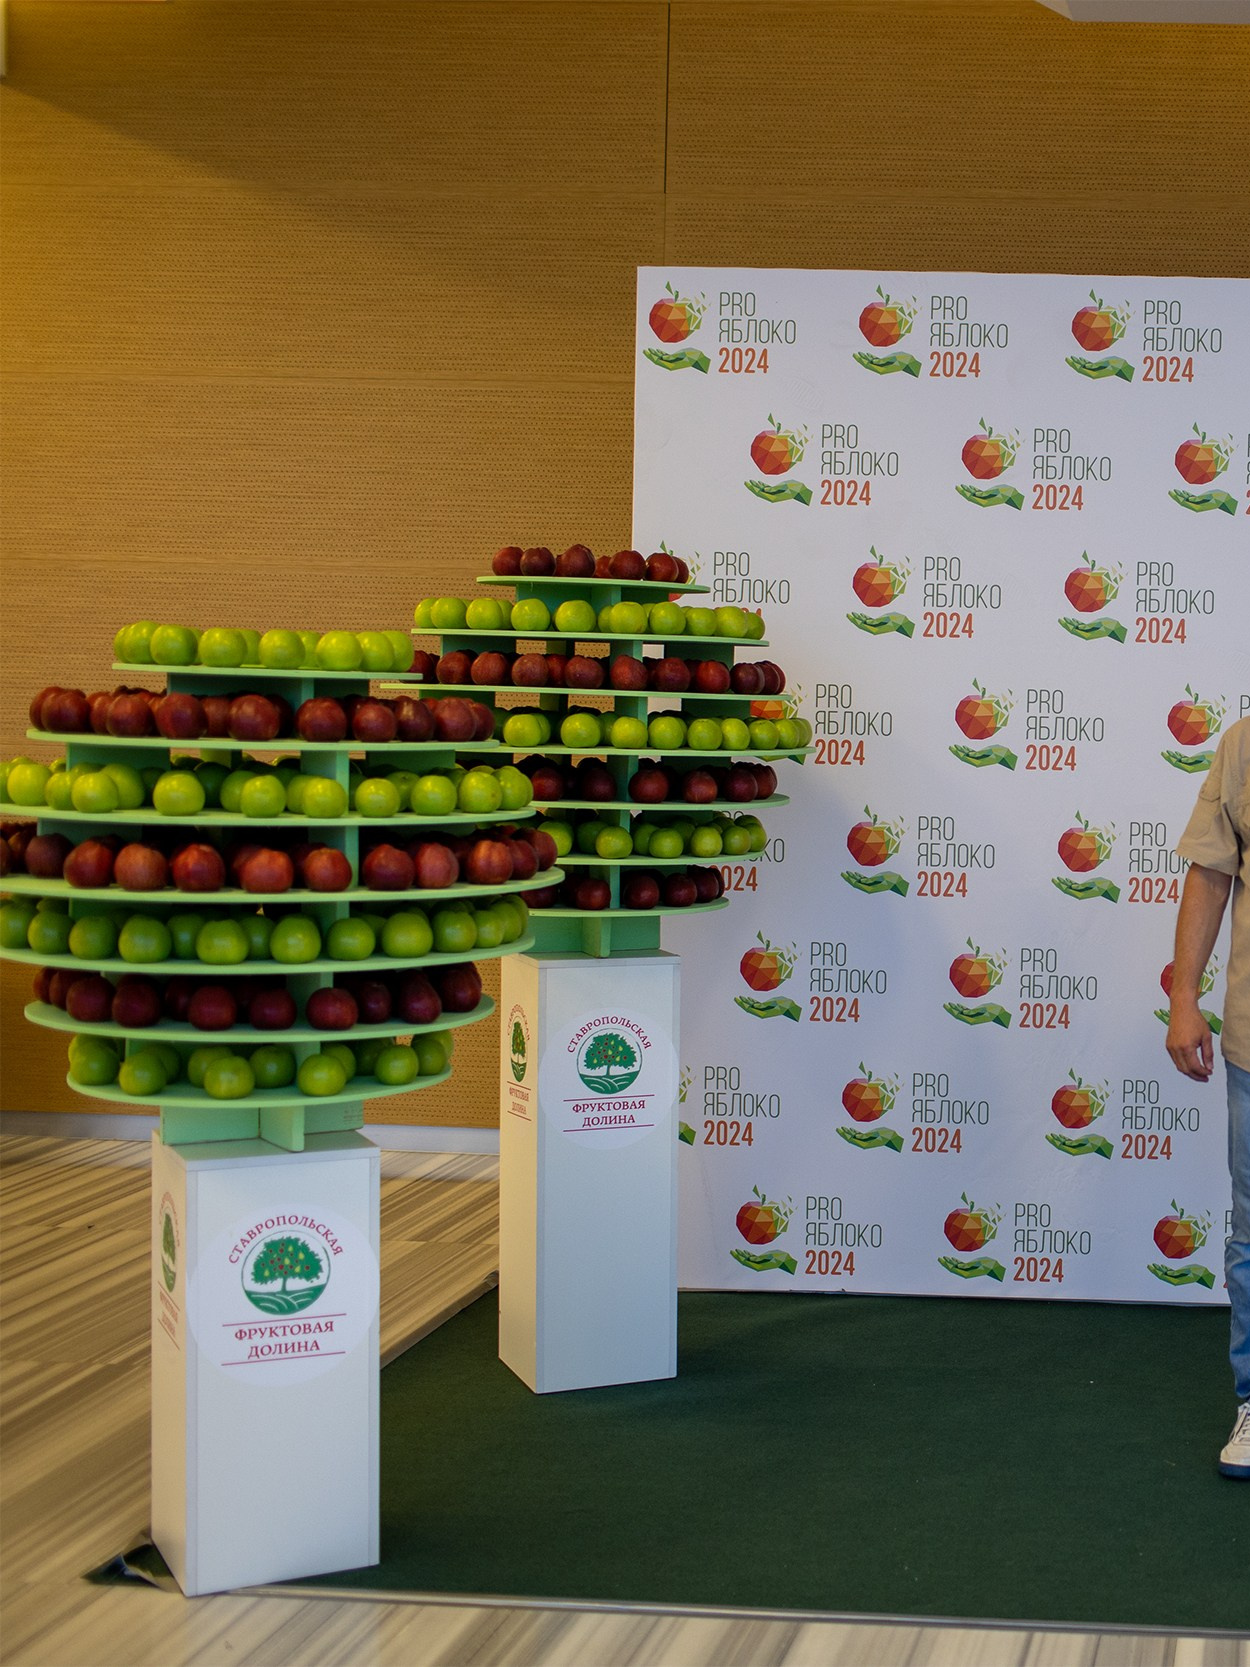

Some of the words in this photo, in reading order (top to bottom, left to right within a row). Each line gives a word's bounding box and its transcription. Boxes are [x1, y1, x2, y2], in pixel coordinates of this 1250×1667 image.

[719, 292, 755, 317] PRO
[931, 296, 967, 320] PRO
[1144, 300, 1181, 325] PRO
[719, 319, 796, 344] ЯБЛОКО
[930, 322, 1008, 348] ЯБЛОКО
[1143, 327, 1222, 353] ЯБЛОКО
[718, 347, 769, 374] 2024
[929, 351, 981, 378] 2024
[1142, 355, 1194, 383] 2024
[822, 424, 858, 449] PRO
[1034, 428, 1070, 453] PRO
[821, 451, 898, 476] ЯБЛОКО
[1033, 455, 1111, 481] ЯБЛОКО
[820, 479, 871, 506] 2024
[1032, 484, 1083, 511] 2024
[714, 552, 750, 577] PRO
[924, 556, 960, 581] PRO
[1137, 562, 1173, 586] PRO
[713, 578, 790, 604] ЯБЛОКО
[923, 582, 1001, 609] ЯБЛОКО
[1136, 588, 1214, 614] ЯБЛОКО
[923, 611, 974, 638] 2024
[1135, 617, 1186, 644] 2024
[816, 684, 852, 709] PRO
[1027, 689, 1063, 714] PRO
[815, 711, 893, 736] ЯБЛОКО
[1026, 716, 1104, 742] ЯБЛОКО
[815, 739, 865, 765] 2024
[1025, 744, 1076, 771] 2024
[918, 816, 954, 841] PRO
[1130, 822, 1166, 847] PRO
[917, 843, 995, 868] ЯБЛОКО
[1129, 848, 1191, 874] ЯБЛОК
[709, 865, 758, 892] 024
[917, 871, 968, 897] 2024
[1128, 876, 1179, 904] 2024
[810, 942, 846, 966] PRO
[1021, 948, 1057, 973] PRO
[810, 968, 887, 995] ЯБЛОКО
[1020, 974, 1097, 1000] ЯБЛОКО
[809, 996, 860, 1023] 2024
[1019, 1003, 1070, 1029] 2024
[567, 1016, 652, 1053] СТАВРОПОЛЬСКАЯ
[704, 1066, 740, 1091] PRO
[913, 1073, 949, 1098] PRO
[1123, 1079, 1159, 1104] PRO
[572, 1100, 646, 1114] ФРУКТОВАЯ
[704, 1092, 780, 1118] ЯБЛОКО
[912, 1099, 989, 1125] ЯБЛОКО
[582, 1114, 636, 1128] ДОЛИНА
[1122, 1106, 1199, 1132] ЯБЛОКО
[704, 1121, 753, 1146] 2024
[912, 1127, 962, 1153] 2024
[1121, 1134, 1172, 1160] 2024
[806, 1196, 842, 1221] PRO
[1015, 1203, 1051, 1227] PRO
[228, 1214, 343, 1264] СТАВРОПОЛЬСКАЯ
[806, 1222, 882, 1248] ЯБЛОКО
[1014, 1229, 1091, 1255] ЯБЛОКО
[805, 1250, 855, 1276] 2024
[1013, 1258, 1064, 1283] 2024
[234, 1321, 334, 1341] ФРУКТОВАЯ
[248, 1340, 320, 1360] ДОЛИНА
